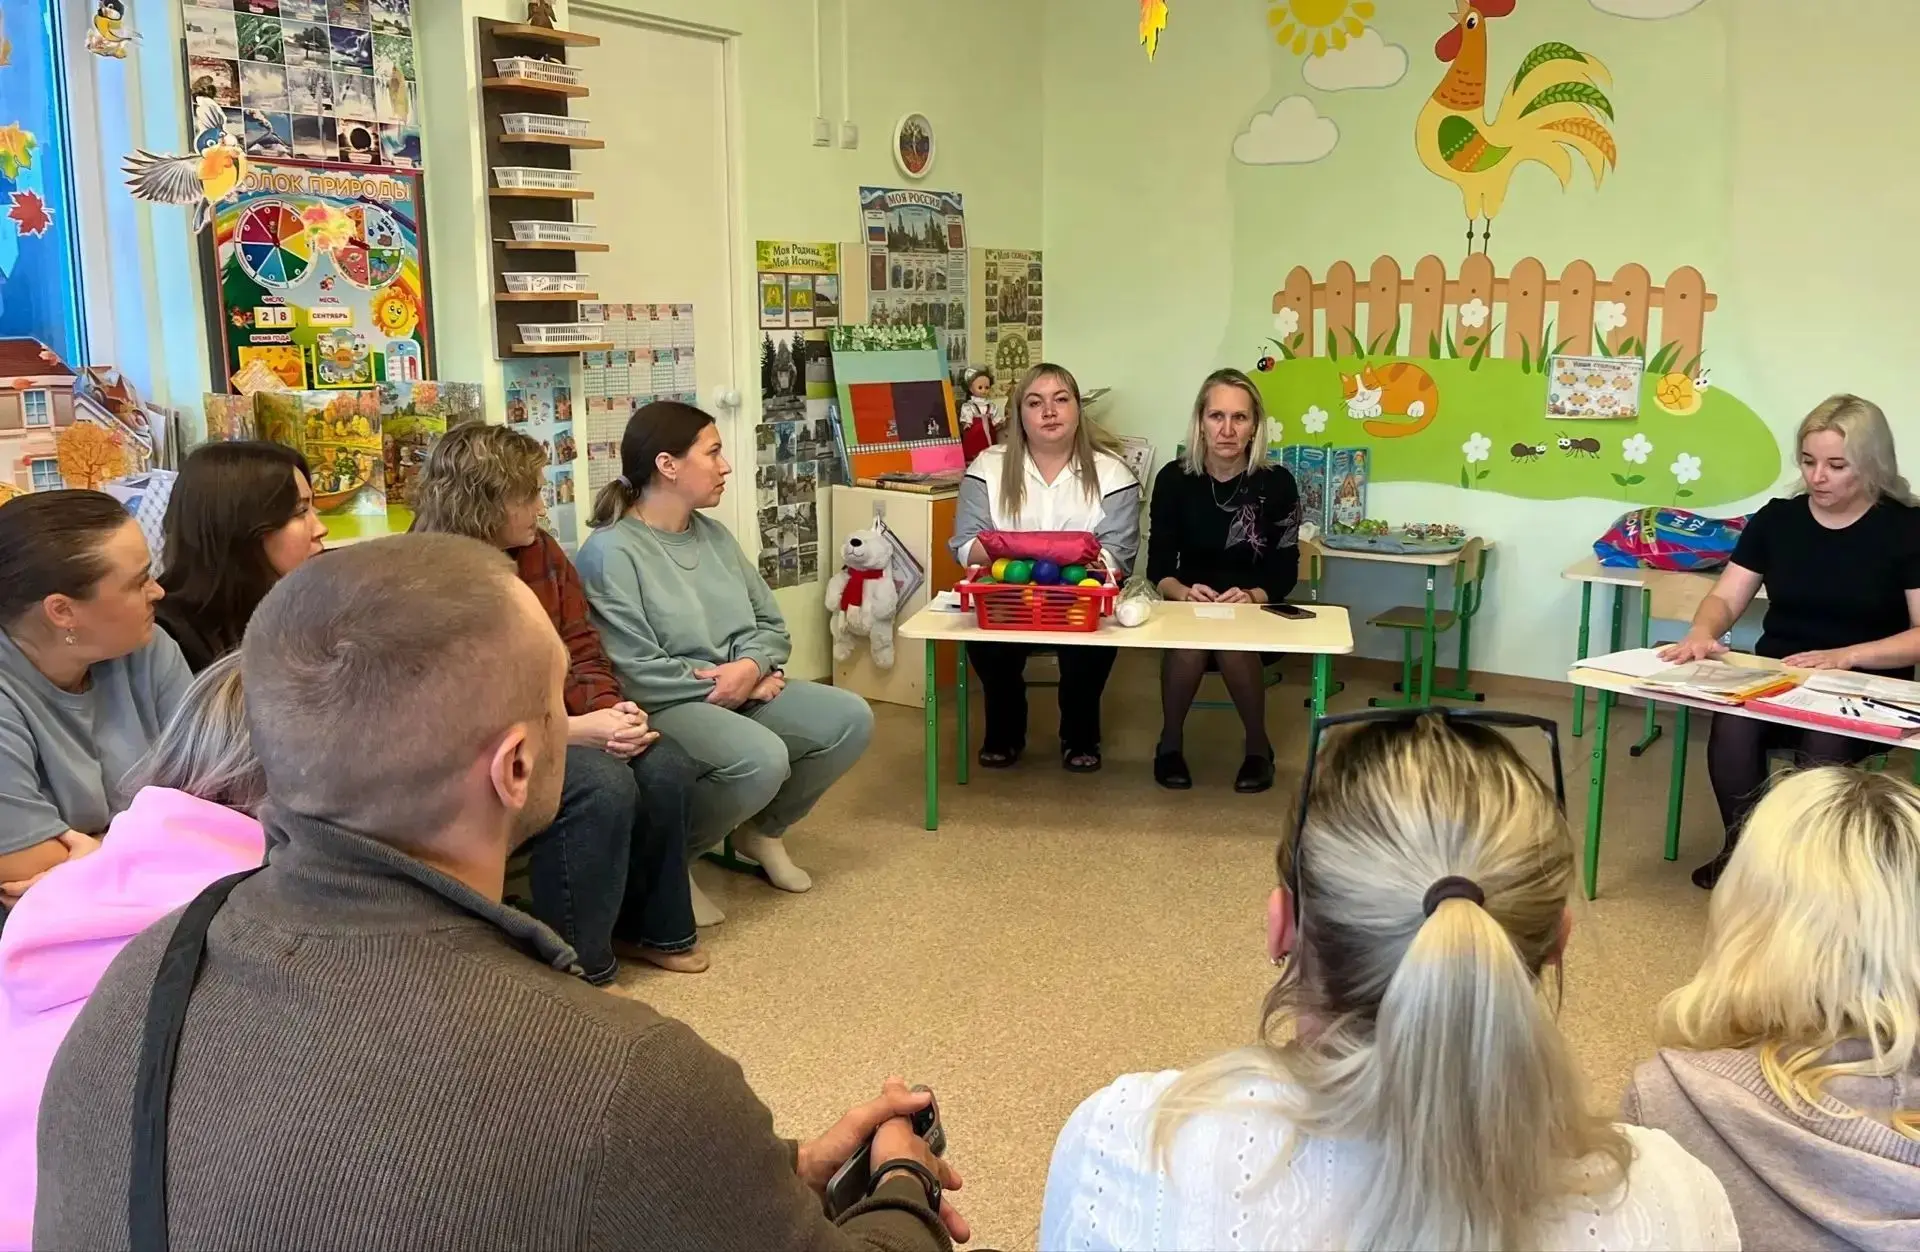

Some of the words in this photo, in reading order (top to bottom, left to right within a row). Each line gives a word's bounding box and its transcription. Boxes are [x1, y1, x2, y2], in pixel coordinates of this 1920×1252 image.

[243, 171, 304, 194] ОЛОК
[308, 175, 410, 203] ПРИРОДЫ
[887, 193, 906, 206] МОЯ
[909, 192, 941, 209] РОССИЯ
[773, 246, 790, 256] Моя
[772, 257, 790, 267] Мой
[262, 311, 269, 321] 2
[280, 311, 287, 321] 8
